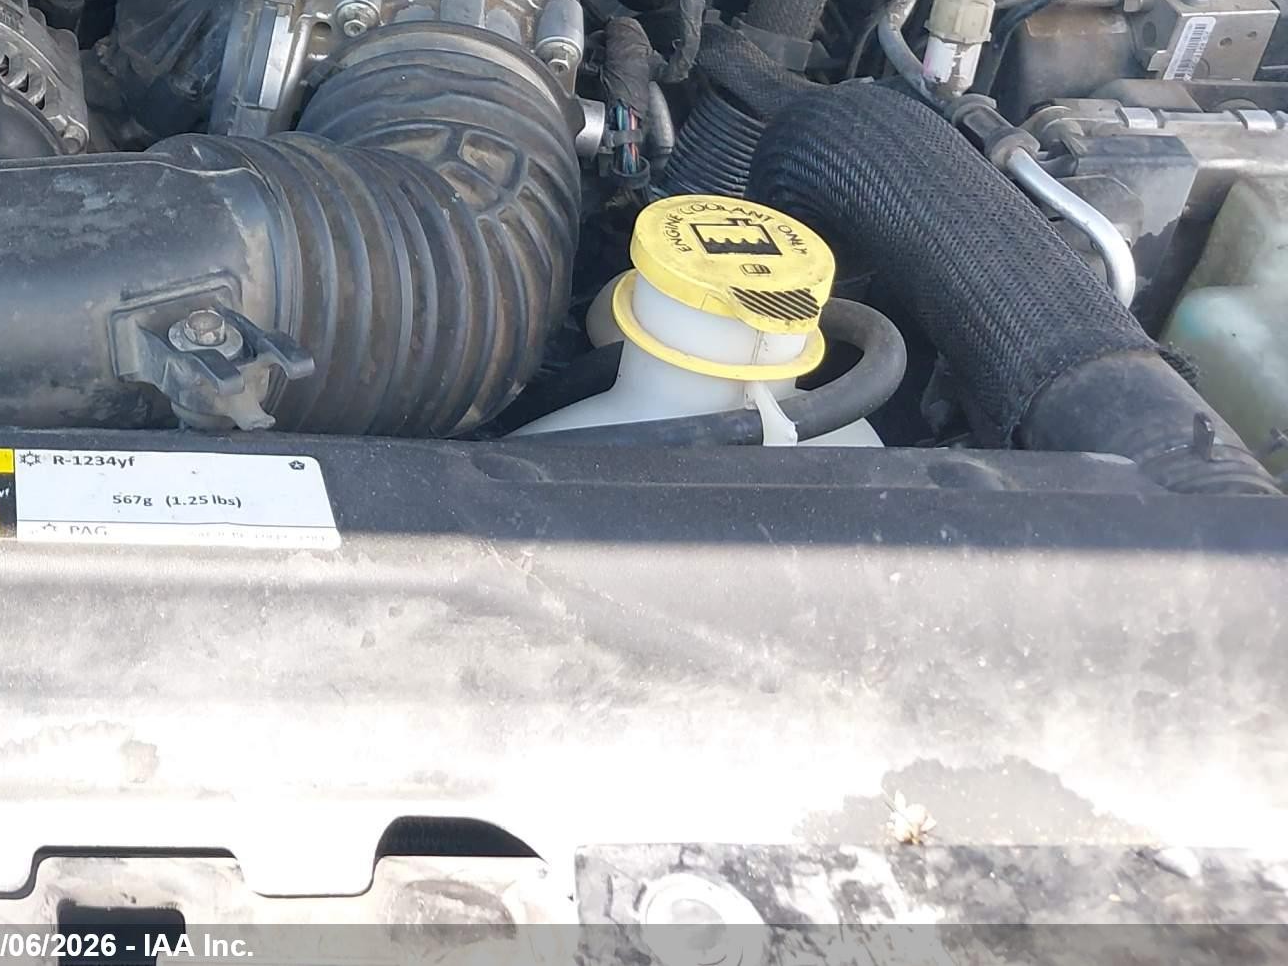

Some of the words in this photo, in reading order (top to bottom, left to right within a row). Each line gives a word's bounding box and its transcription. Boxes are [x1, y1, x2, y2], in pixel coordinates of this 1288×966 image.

[665, 213, 693, 253] ENGINE
[679, 203, 775, 222] COOLANT
[777, 224, 808, 255] ONLY
[52, 455, 136, 469] R-1234yf
[112, 494, 153, 507] 567g
[165, 494, 209, 508] (1.25
[211, 493, 242, 509] lbs)
